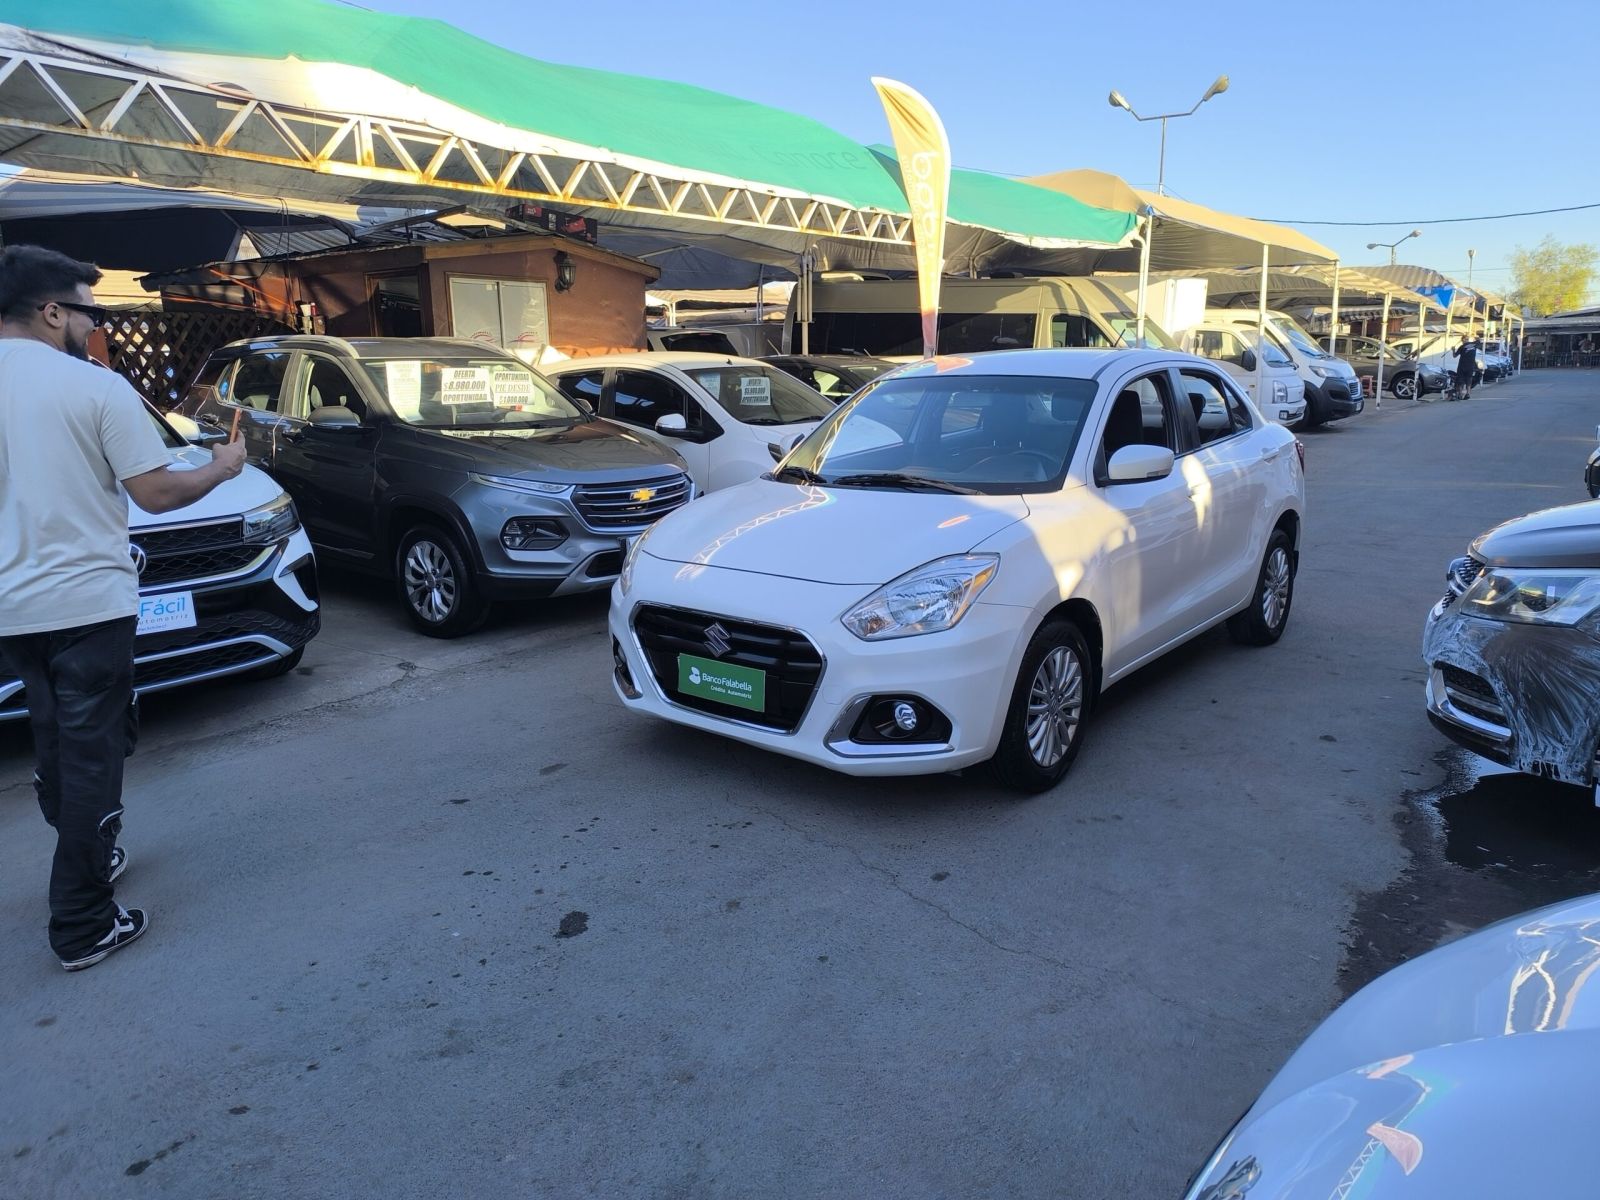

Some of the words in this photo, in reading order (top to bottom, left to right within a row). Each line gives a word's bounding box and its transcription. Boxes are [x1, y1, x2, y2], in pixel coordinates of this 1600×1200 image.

[454, 370, 475, 378] OFERTA
[494, 372, 529, 381] OPORTUNIDAD
[443, 393, 488, 402] OPORTUNIDAD
[140, 597, 185, 618] Fácil
